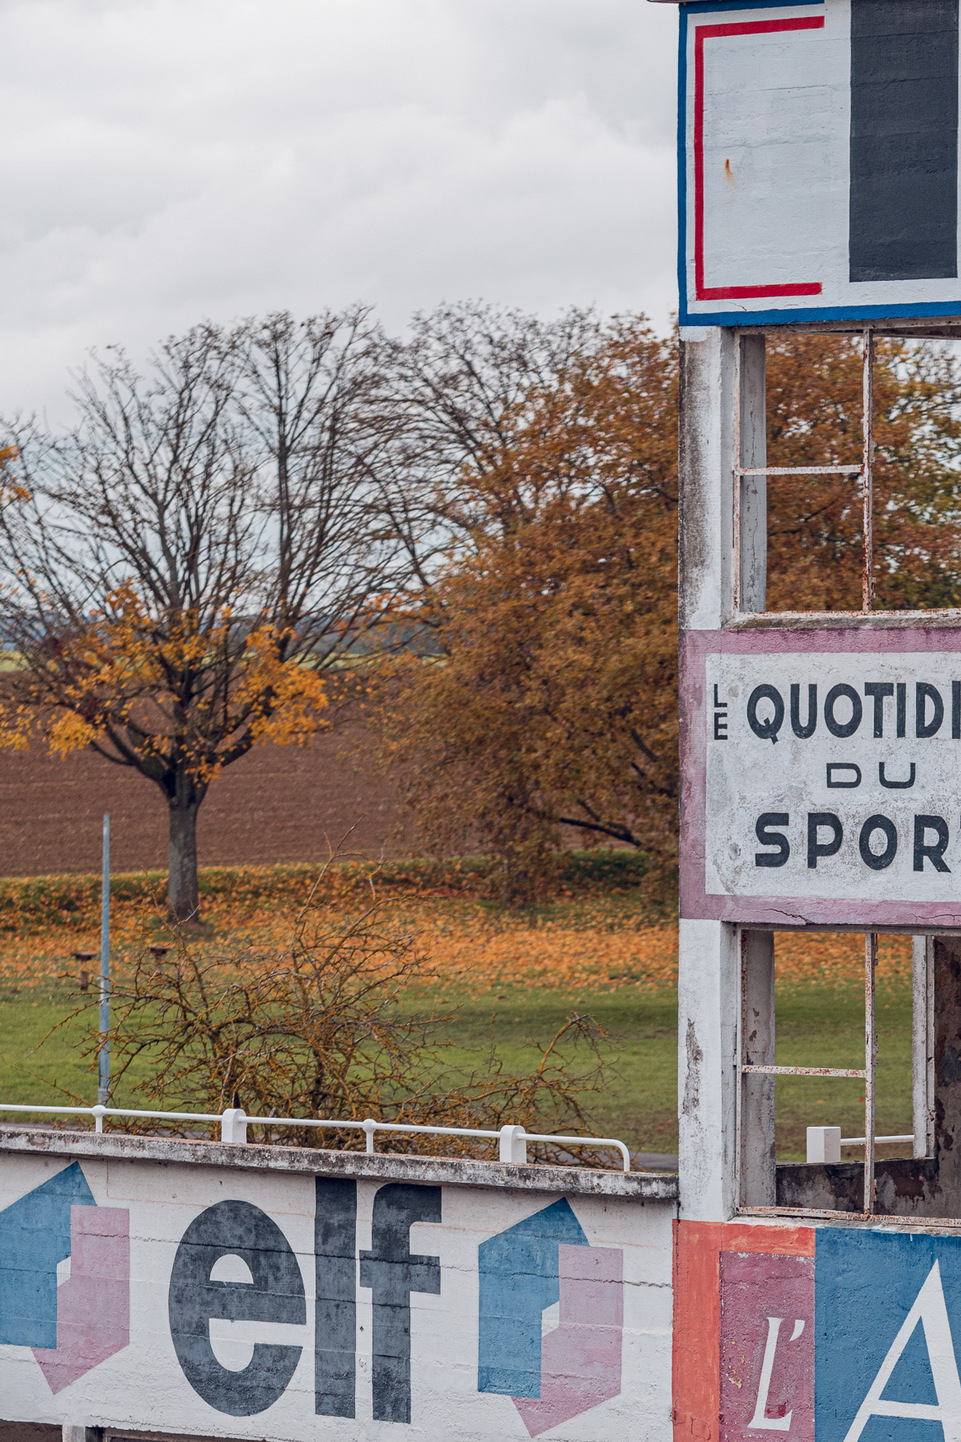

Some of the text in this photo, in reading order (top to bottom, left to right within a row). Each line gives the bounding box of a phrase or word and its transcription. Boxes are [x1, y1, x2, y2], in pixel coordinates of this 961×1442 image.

[713, 684, 728, 740] LE
[826, 762, 916, 789] DU
[168, 1176, 441, 1424] elf
